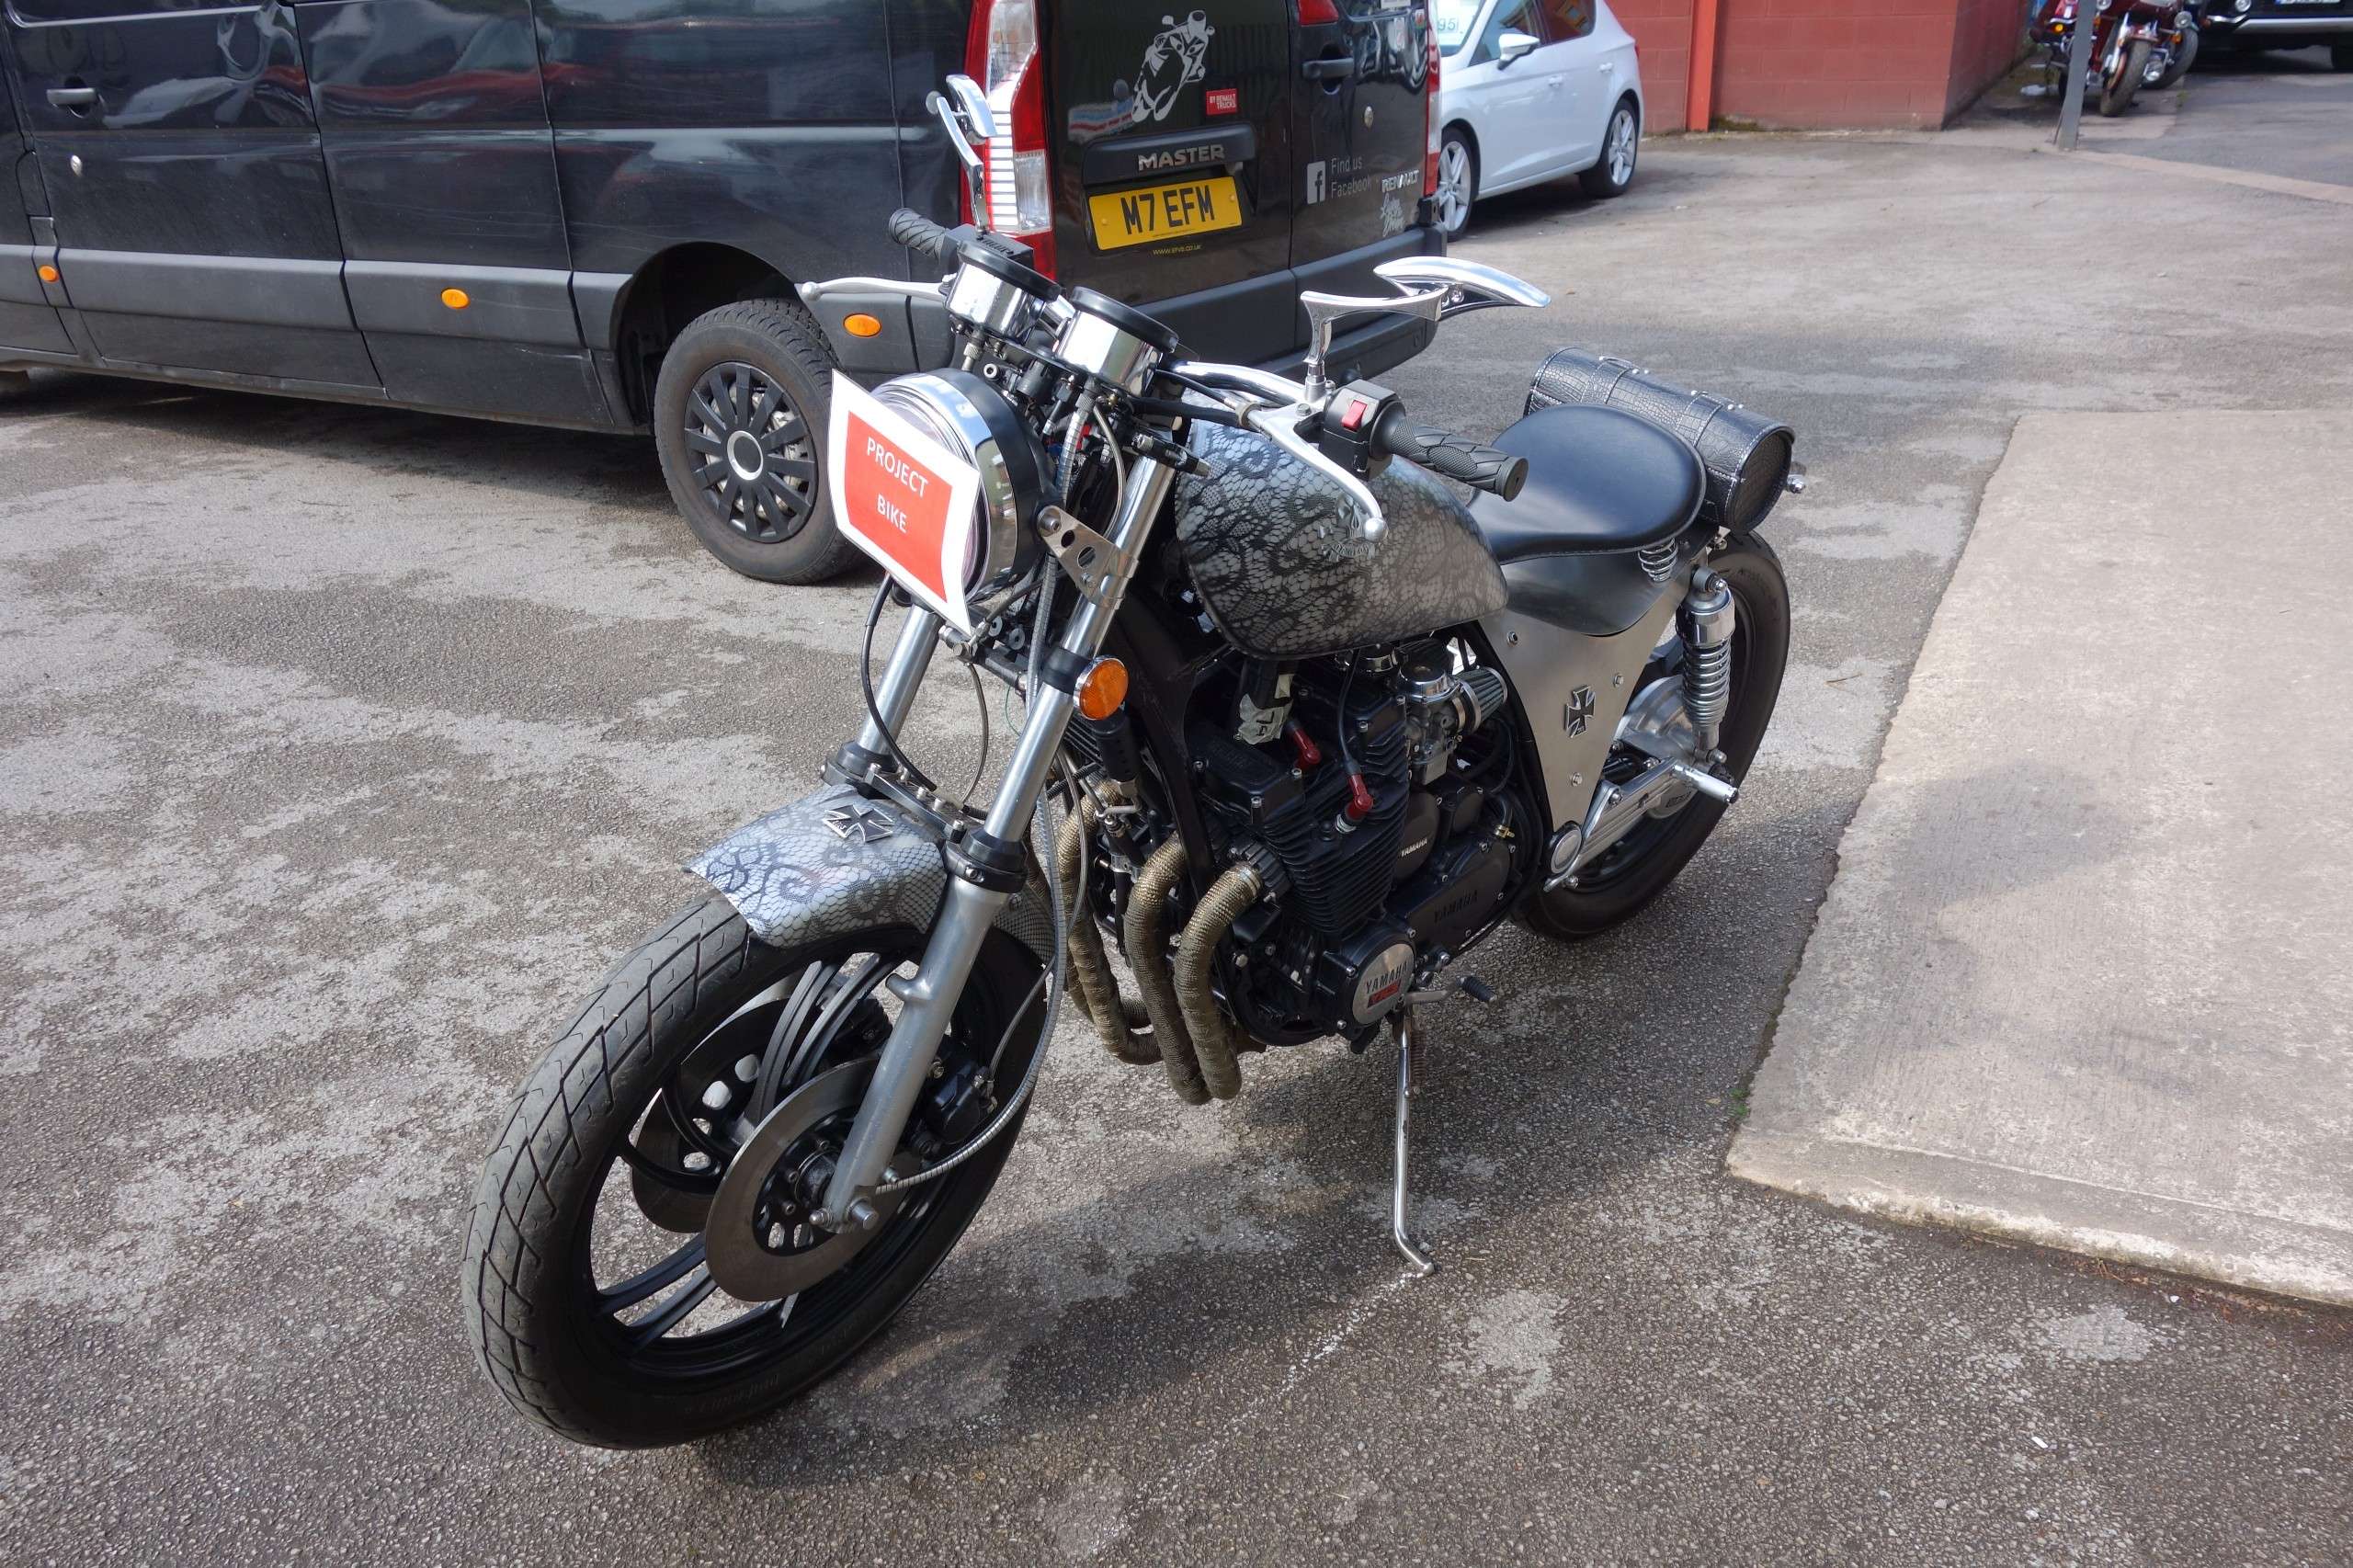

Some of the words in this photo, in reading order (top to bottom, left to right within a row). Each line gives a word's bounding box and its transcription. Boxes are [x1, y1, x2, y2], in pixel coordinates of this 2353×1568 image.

[1138, 144, 1225, 171] MASTER
[1331, 156, 1350, 175] Find
[1353, 156, 1363, 170] us
[1331, 175, 1372, 199] Facebook
[1381, 169, 1419, 193] RENAULT
[1120, 193, 1155, 235] M7
[1163, 185, 1215, 228] EFM
[867, 437, 928, 497] PROJECT
[877, 494, 907, 534] BIKE
[1400, 837, 1427, 858] YAMAHA
[1434, 890, 1478, 923] YAMAHA
[1366, 960, 1407, 994] YAMAHA
